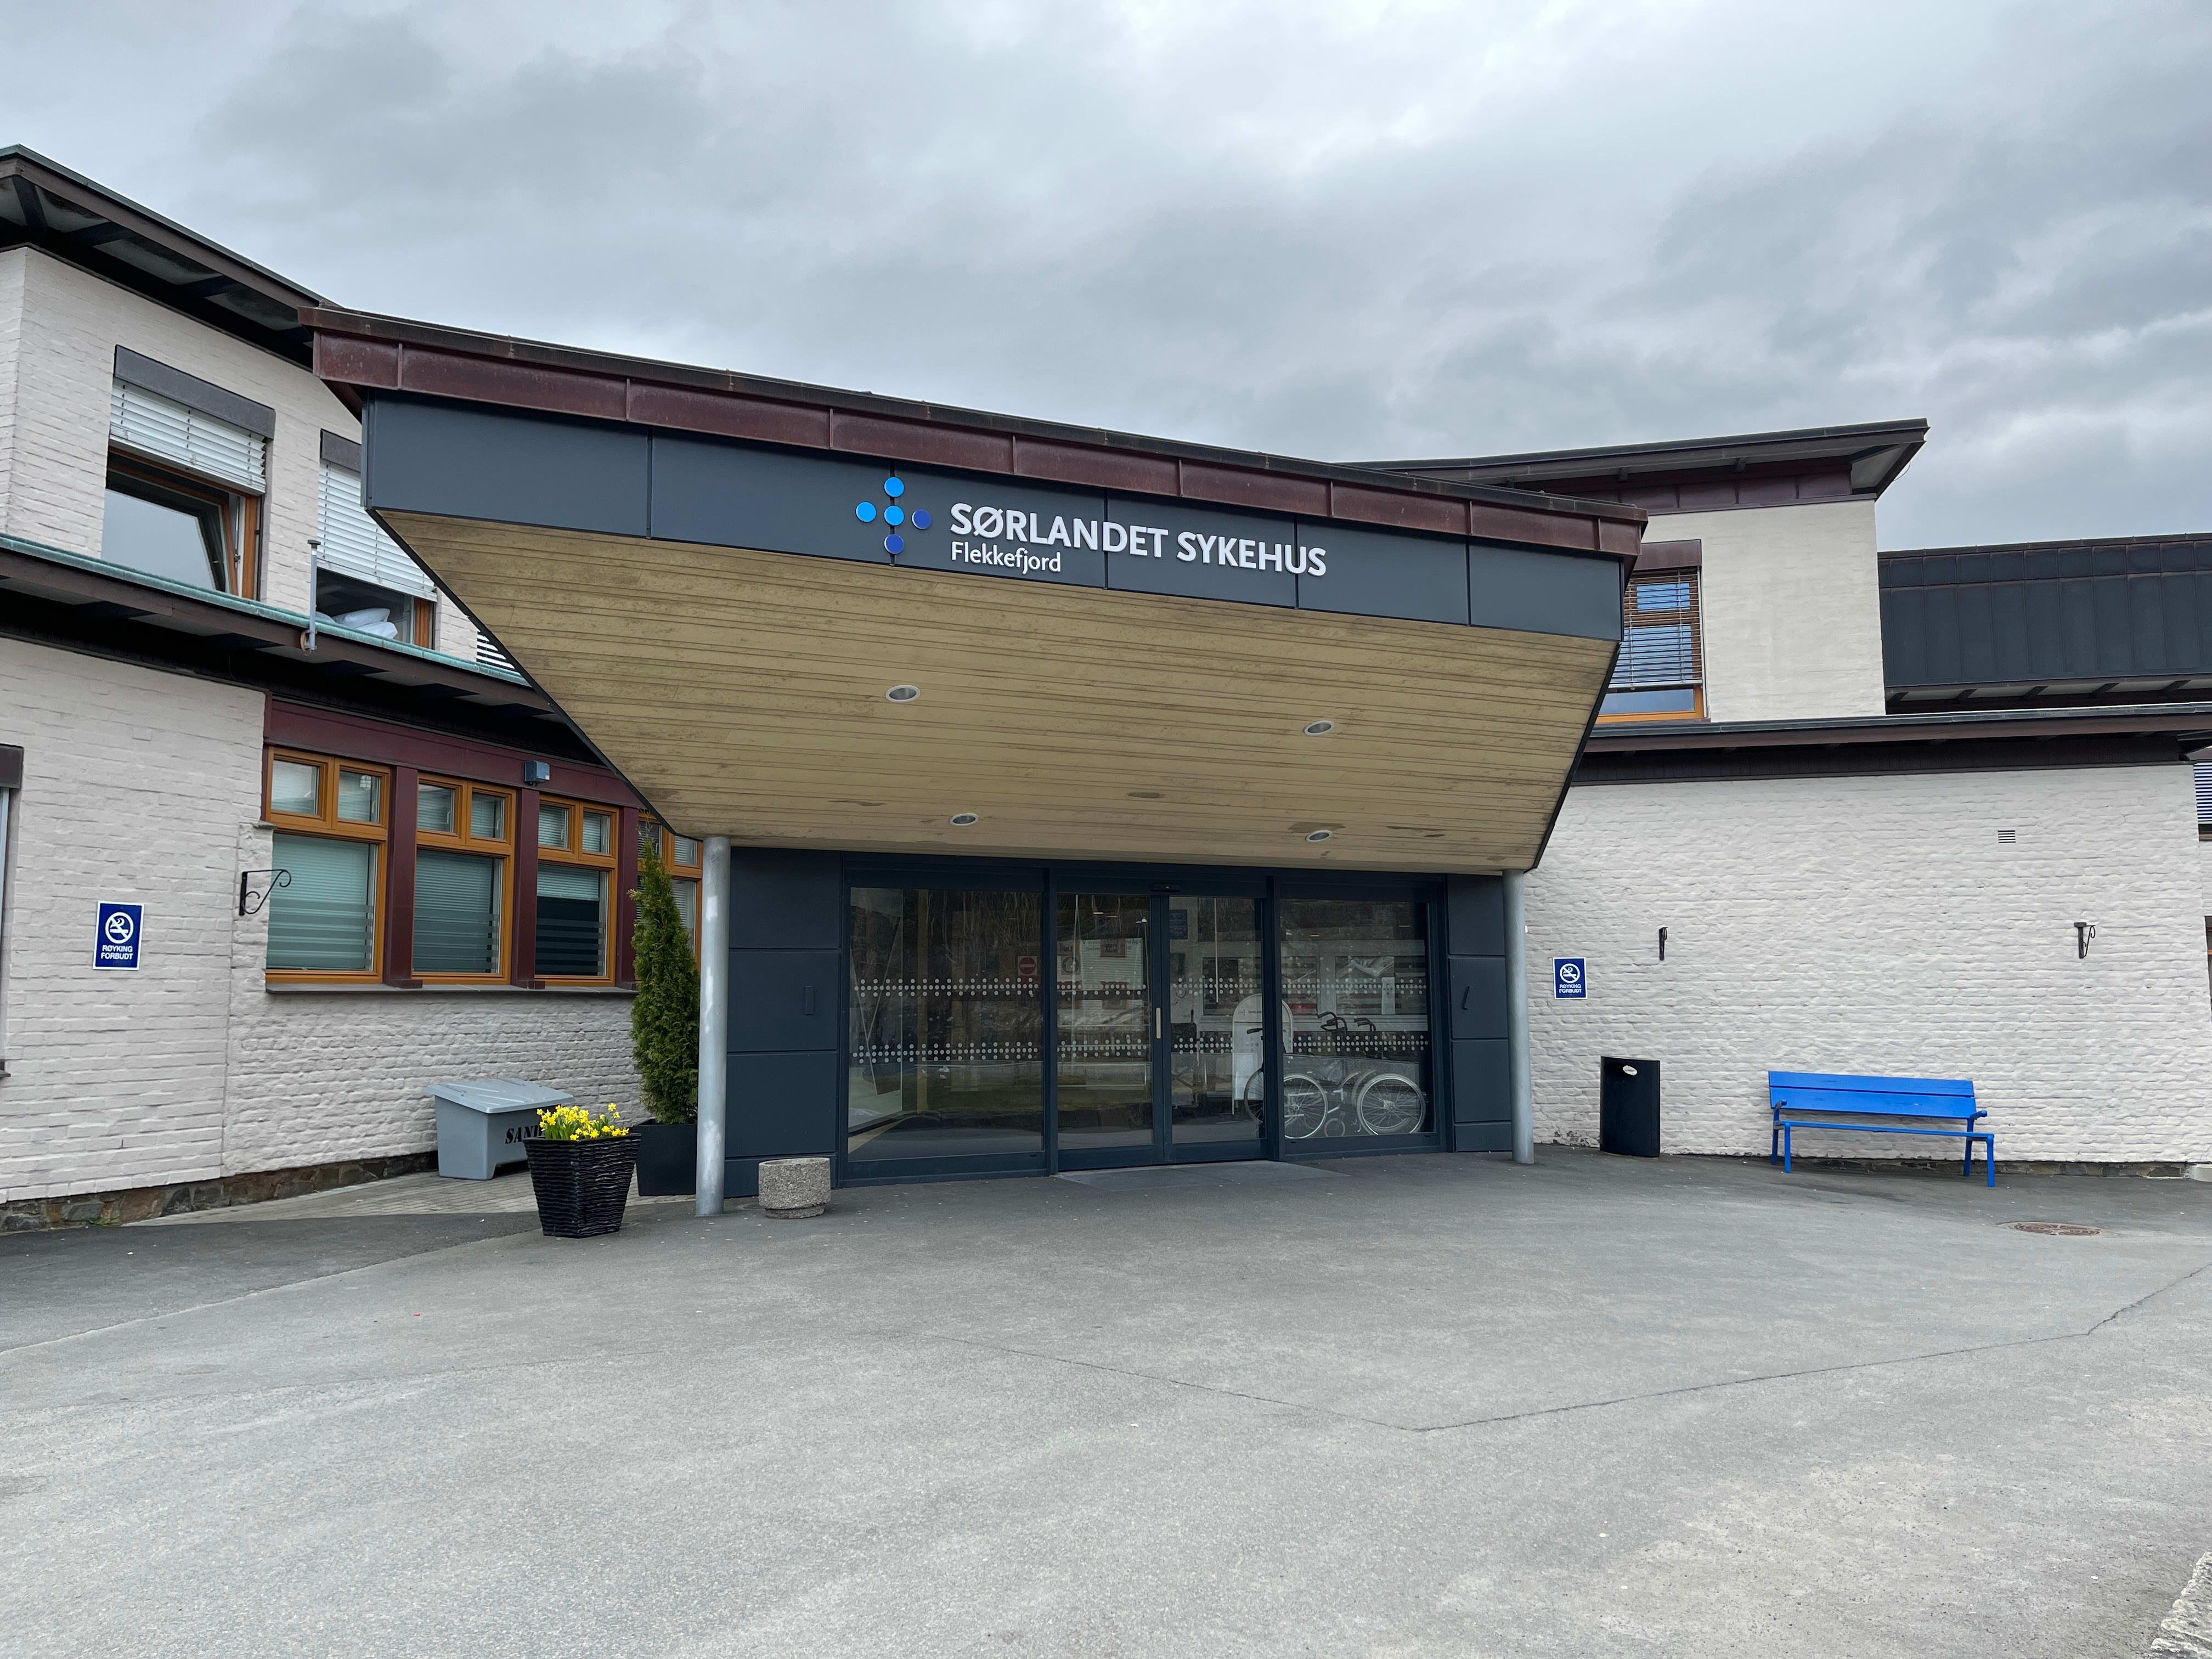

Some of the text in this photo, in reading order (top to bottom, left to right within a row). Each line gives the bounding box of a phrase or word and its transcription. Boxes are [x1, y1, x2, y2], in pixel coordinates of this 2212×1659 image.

[950, 503, 1327, 576] SØRLANDET SYKEHUS
[952, 541, 1061, 574] Flekkefjord
